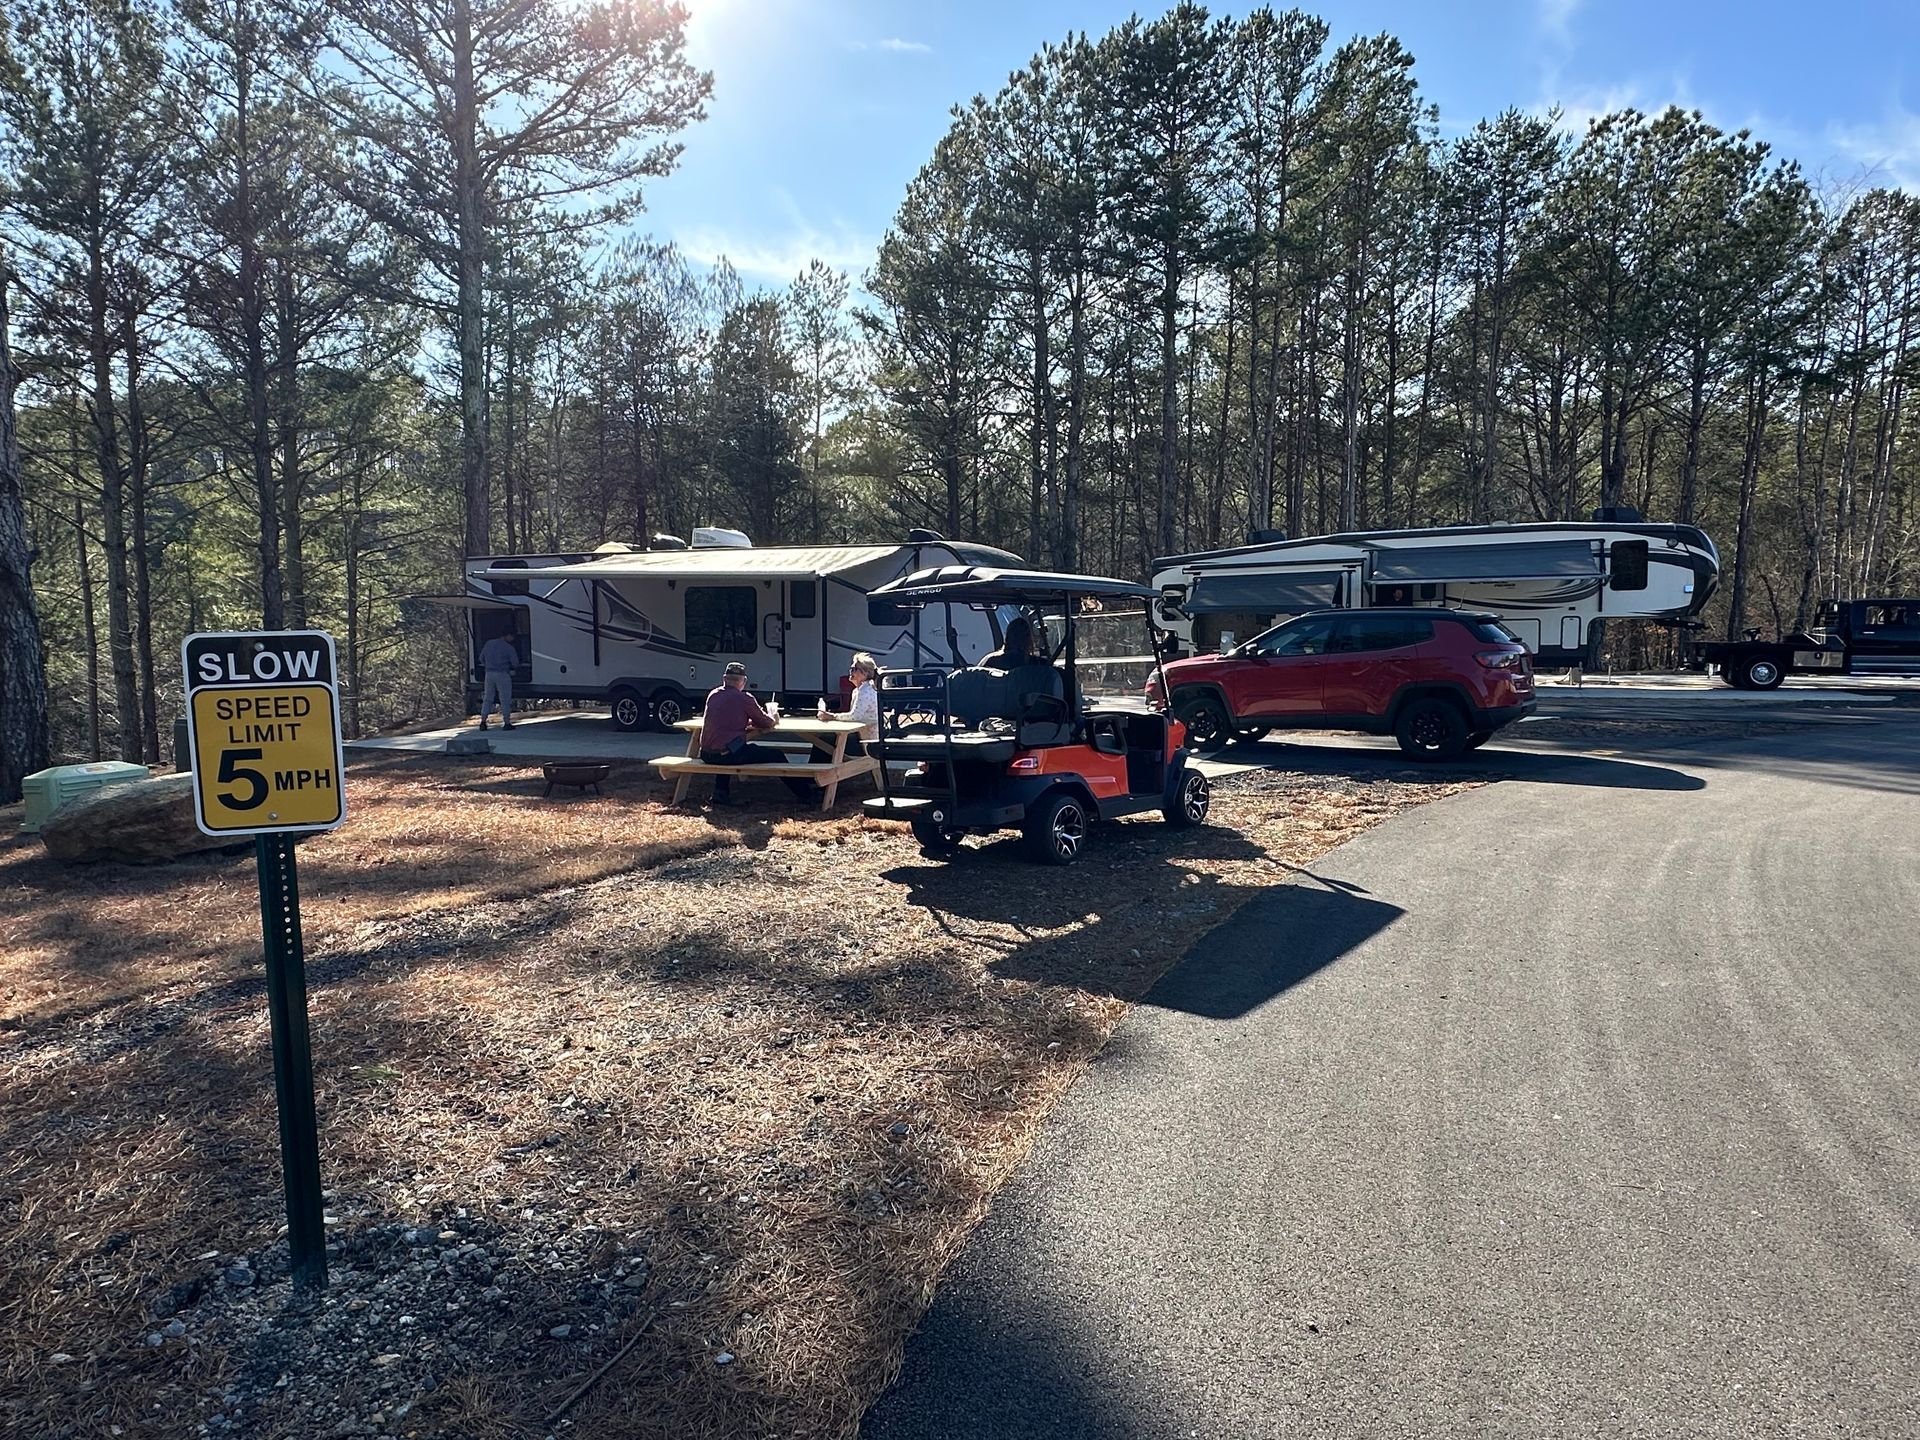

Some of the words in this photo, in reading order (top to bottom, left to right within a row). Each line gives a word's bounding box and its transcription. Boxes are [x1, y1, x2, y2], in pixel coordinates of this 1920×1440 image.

[198, 650, 320, 682] SLOW
[216, 696, 311, 720] SPEED
[228, 723, 301, 743] LIMIT
[216, 748, 269, 811] 5
[274, 769, 331, 791] MPH
